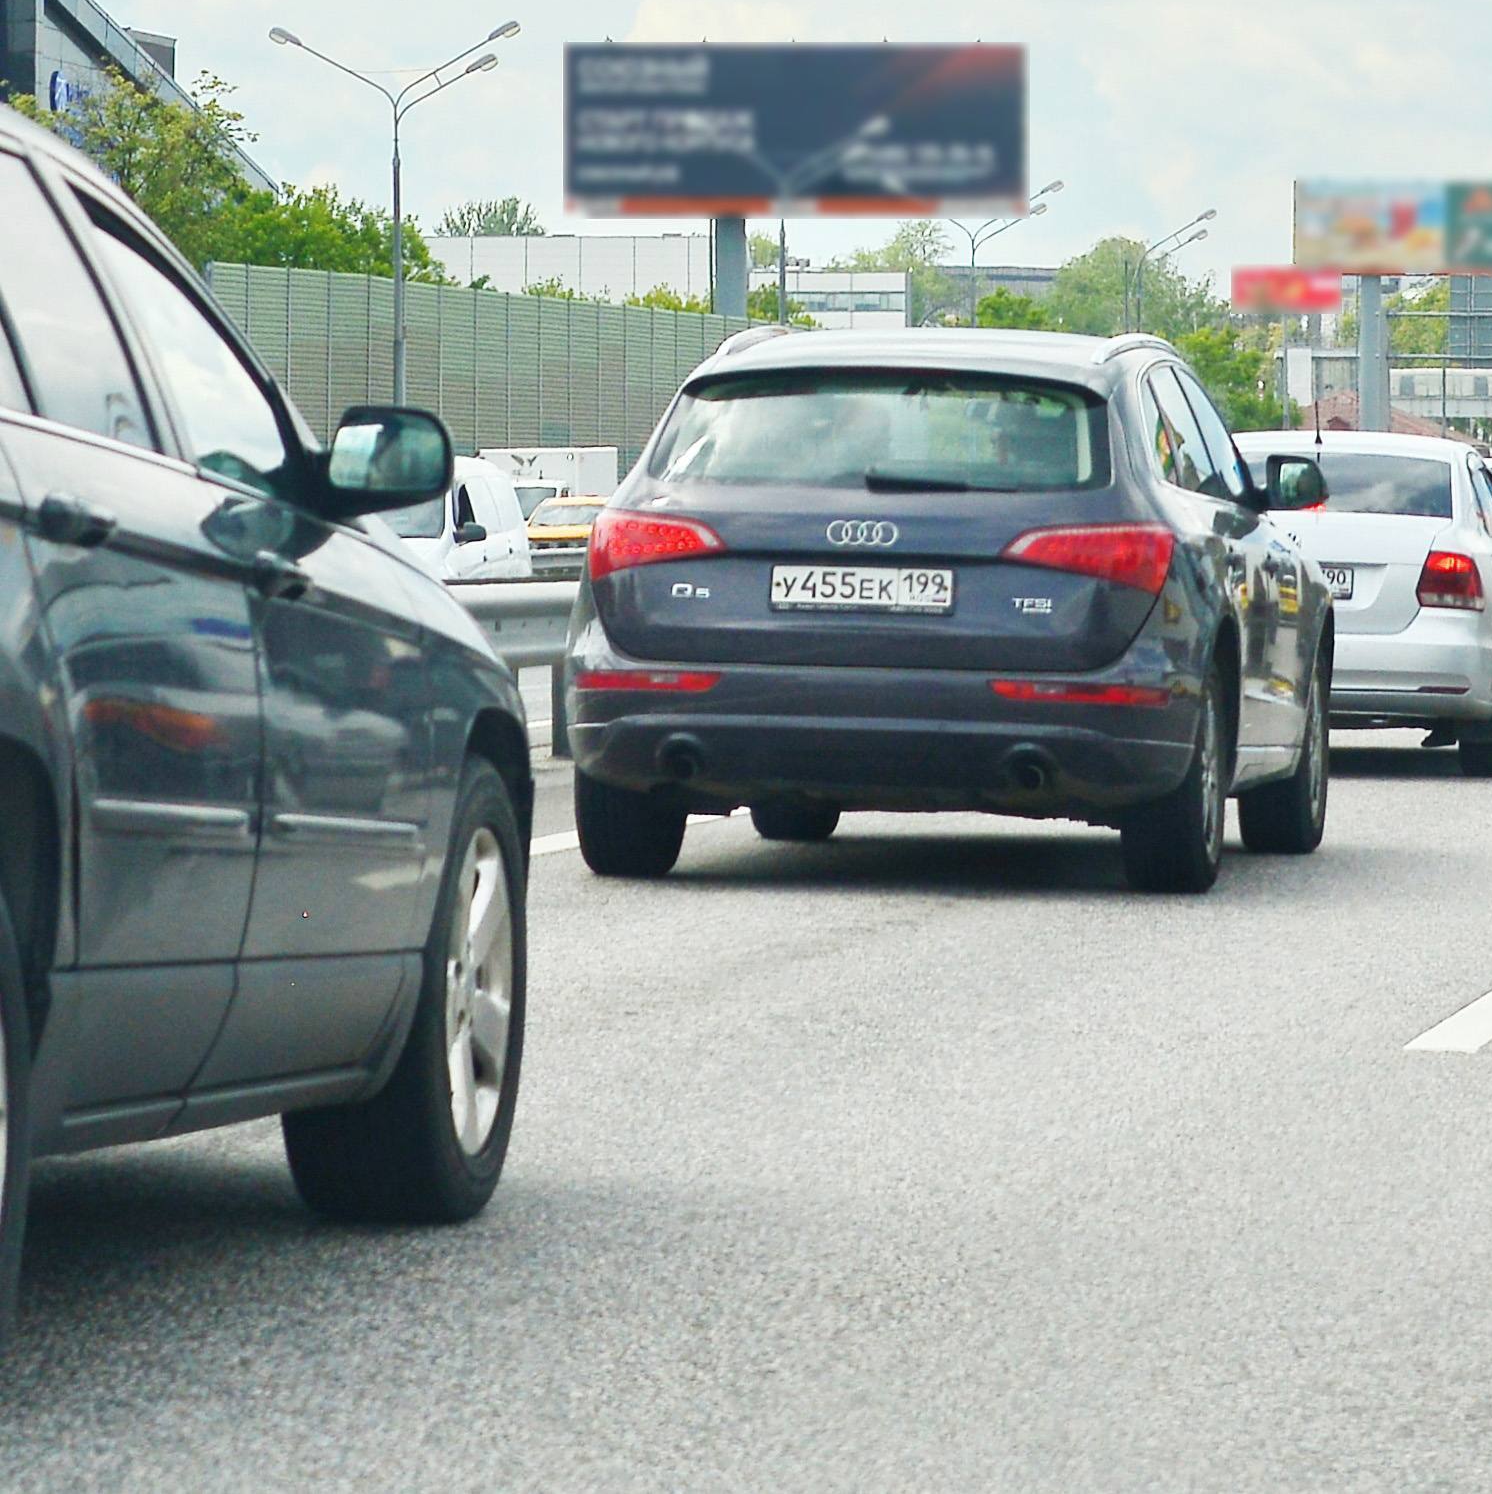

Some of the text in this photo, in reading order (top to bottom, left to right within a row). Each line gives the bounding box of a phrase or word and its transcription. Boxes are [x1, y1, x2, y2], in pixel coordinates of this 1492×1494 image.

[1322, 570, 1346, 584] 90
[671, 583, 710, 598] Q5
[783, 571, 945, 600] У455ЕК 199
[1012, 597, 1052, 608] TFSI
